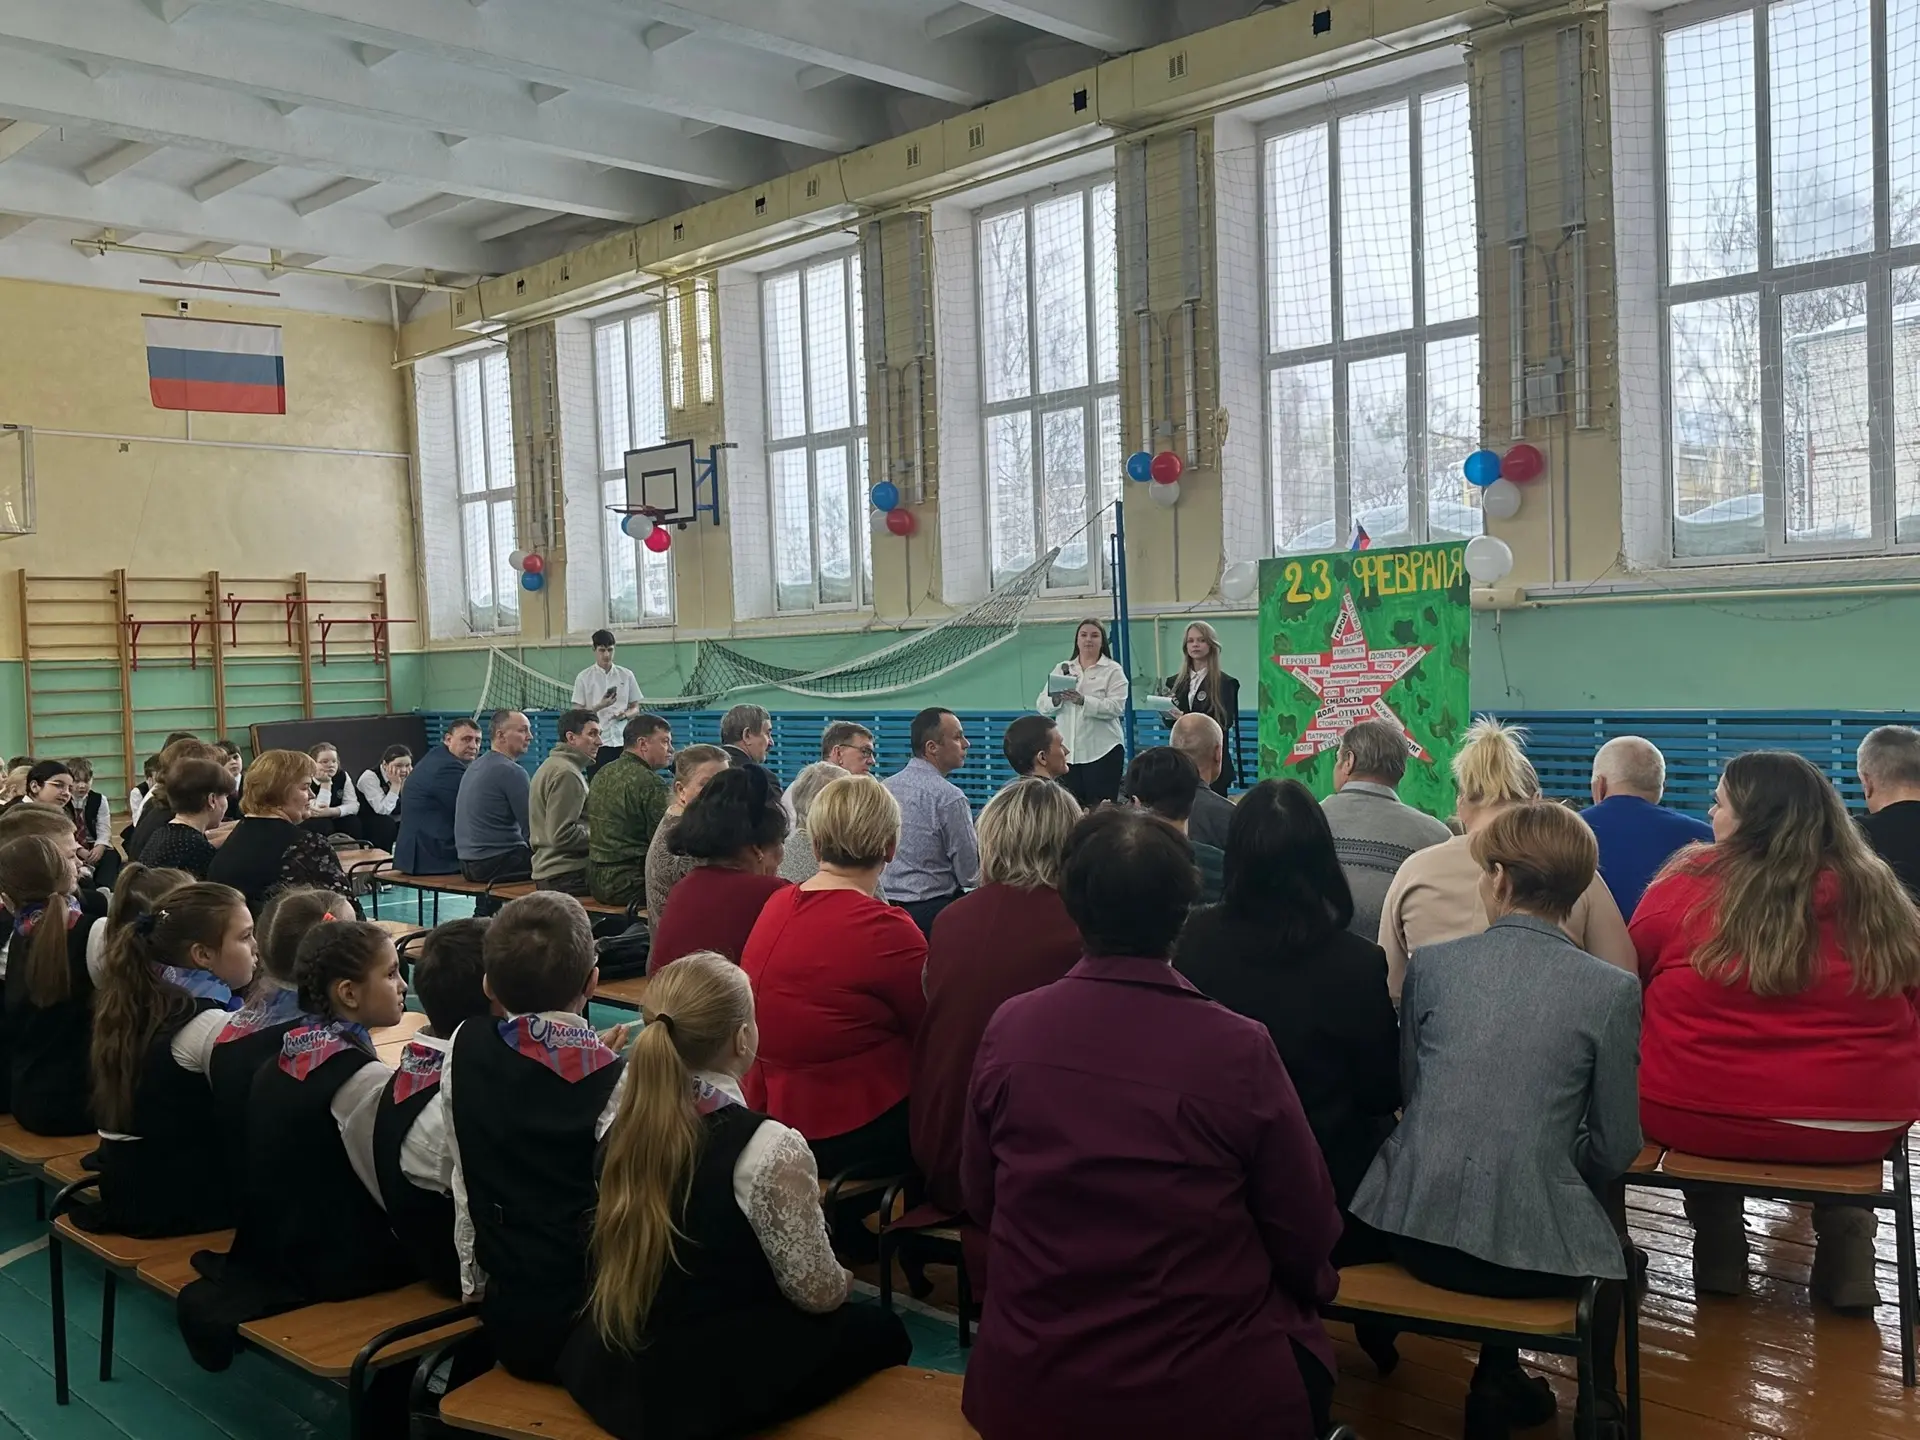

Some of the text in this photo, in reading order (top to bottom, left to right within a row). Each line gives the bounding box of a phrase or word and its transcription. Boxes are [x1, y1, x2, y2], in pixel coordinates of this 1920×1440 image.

[1285, 547, 1463, 603] 23 ФЕВРАЛЯ
[1344, 595, 1361, 629] БРАТСТВО
[1334, 612, 1348, 639] ГЕРОЙ
[1344, 632, 1362, 642] ВОЛЯ
[1334, 647, 1365, 656] ГОРДОСТЬ
[1369, 650, 1407, 661] ДОБЛЕСТЬ
[1281, 657, 1317, 665] ГЕРОИЗМ
[1331, 662, 1367, 672] ХРАБРОСТЬ
[1294, 669, 1320, 692] ЧЕСТНОСТЬ
[1345, 686, 1381, 695] МУДРОСТЬ
[1325, 697, 1362, 705] СМЕЛОСТЬ
[1316, 706, 1336, 719] ДОЛГ
[1338, 707, 1370, 717] ОТВАГА
[1317, 719, 1353, 727] СТОЙКОСТЬ
[1295, 744, 1313, 752] ВОЛЯ
[1406, 741, 1422, 754] ОЛГ
[528, 1014, 597, 1043] Орлята
